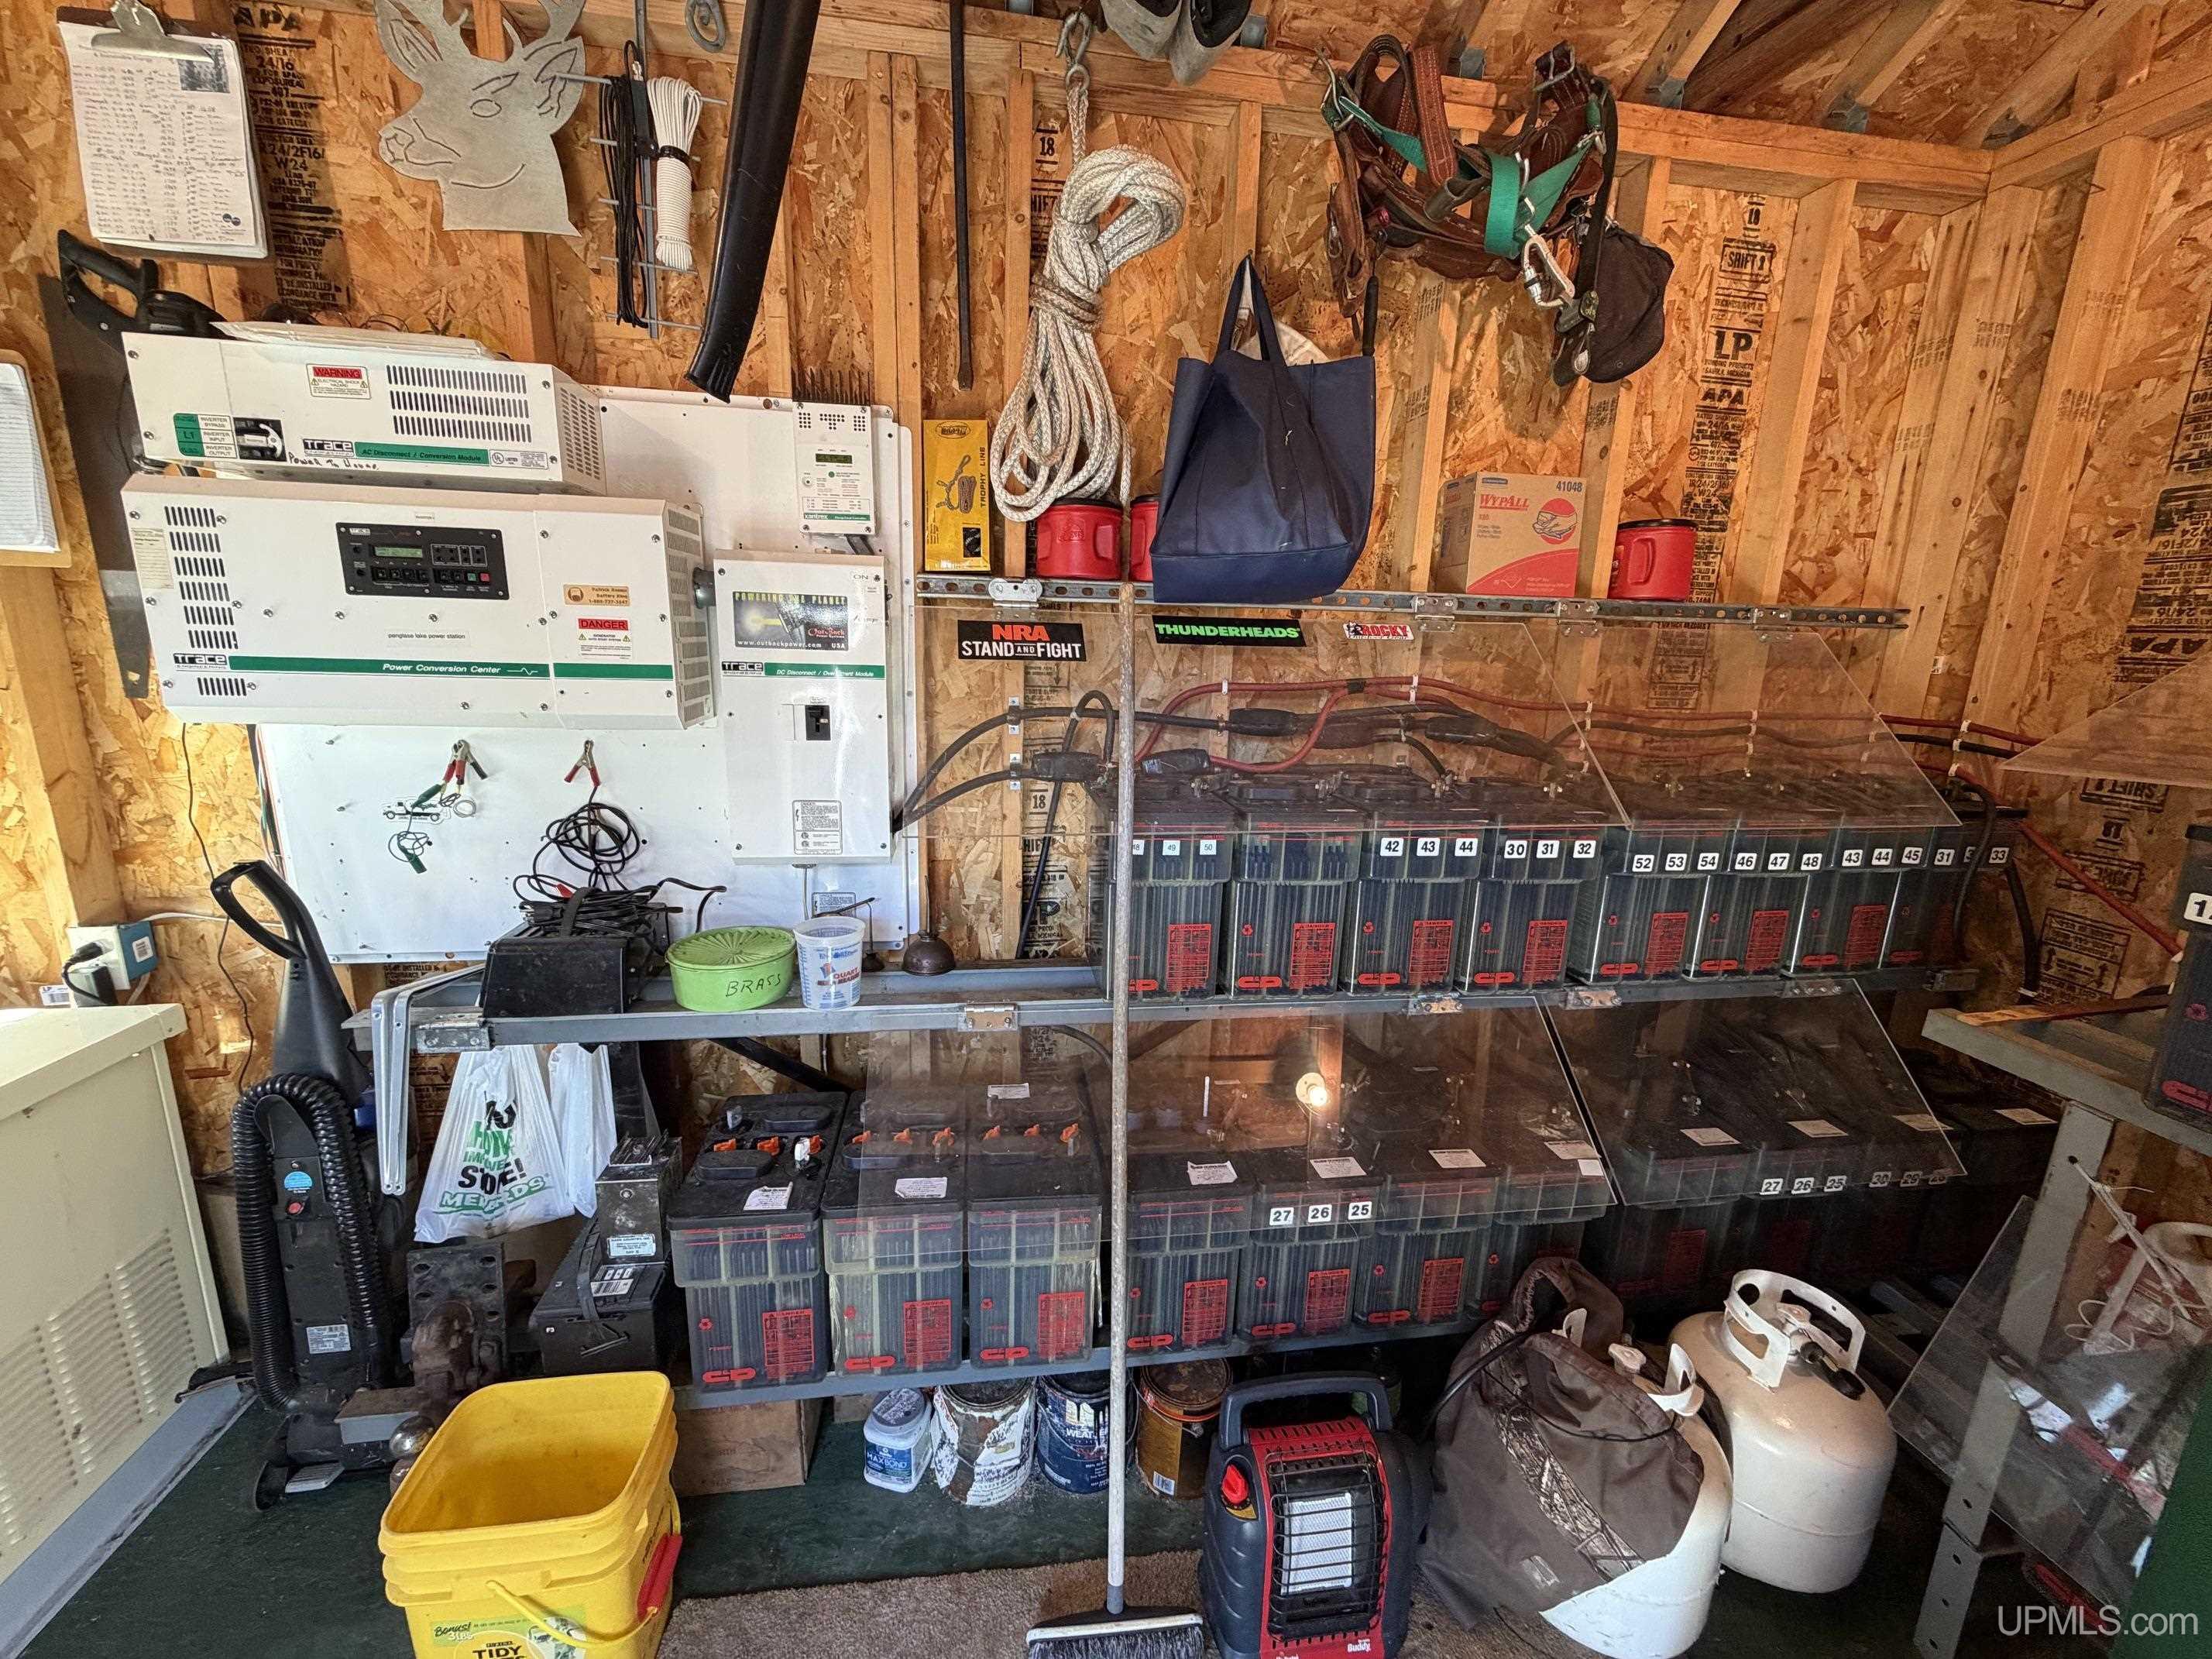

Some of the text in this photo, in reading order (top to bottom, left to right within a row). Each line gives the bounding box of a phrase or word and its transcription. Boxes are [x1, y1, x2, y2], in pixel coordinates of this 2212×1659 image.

[1040, 137, 1054, 156] 18
[1728, 251, 1757, 272] SHIFT
[1714, 330, 1753, 360] LP
[314, 367, 359, 378] WARNING
[1701, 388, 1744, 405] APA
[373, 450, 410, 459] Disconnect
[420, 452, 456, 461] Conversion
[1556, 480, 1582, 493] 41048
[812, 595, 846, 605] PLANET
[581, 620, 626, 629] DANGER
[992, 624, 1050, 641] NRA
[1156, 623, 1299, 639] THUNDERHEADS
[1362, 625, 1408, 637] ROCKY
[737, 640, 822, 649] www.outbackpower.com
[961, 641, 1015, 658] STAND
[1036, 642, 1081, 658] FIGHT
[2131, 637, 2208, 654] APA
[383, 663, 501, 674] Power Conversion Center
[1032, 795, 1046, 809] 18
[1385, 841, 1400, 852] 42
[1421, 841, 1435, 852] 43
[1458, 841, 1473, 852] 44
[1507, 843, 1524, 855] 30
[1541, 843, 1554, 854] 31
[1577, 843, 1591, 854] 32
[1845, 853, 1860, 864] 43
[1875, 851, 1890, 862] 44
[1905, 850, 1919, 860] 45
[1938, 852, 1951, 863] 31
[1991, 850, 2006, 860] 33
[1635, 857, 1651, 868] 52
[1668, 856, 1684, 867] 53
[1700, 855, 1716, 867] 54
[1737, 856, 1753, 867] 46
[1771, 856, 1787, 867] 47
[1803, 856, 1819, 867] 48
[726, 974, 781, 998] BRASS
[1764, 1181, 1781, 1193] 27
[1796, 1180, 1812, 1191] 26
[1826, 1178, 1844, 1190] 25
[1311, 1206, 1330, 1219] 26
[1352, 1204, 1369, 1216] 25
[1273, 1210, 1291, 1222] 27
[434, 1622, 472, 1637] Bonus!
[472, 1646, 523, 1659] TIDY
[1347, 1643, 1371, 1653] Buddy
